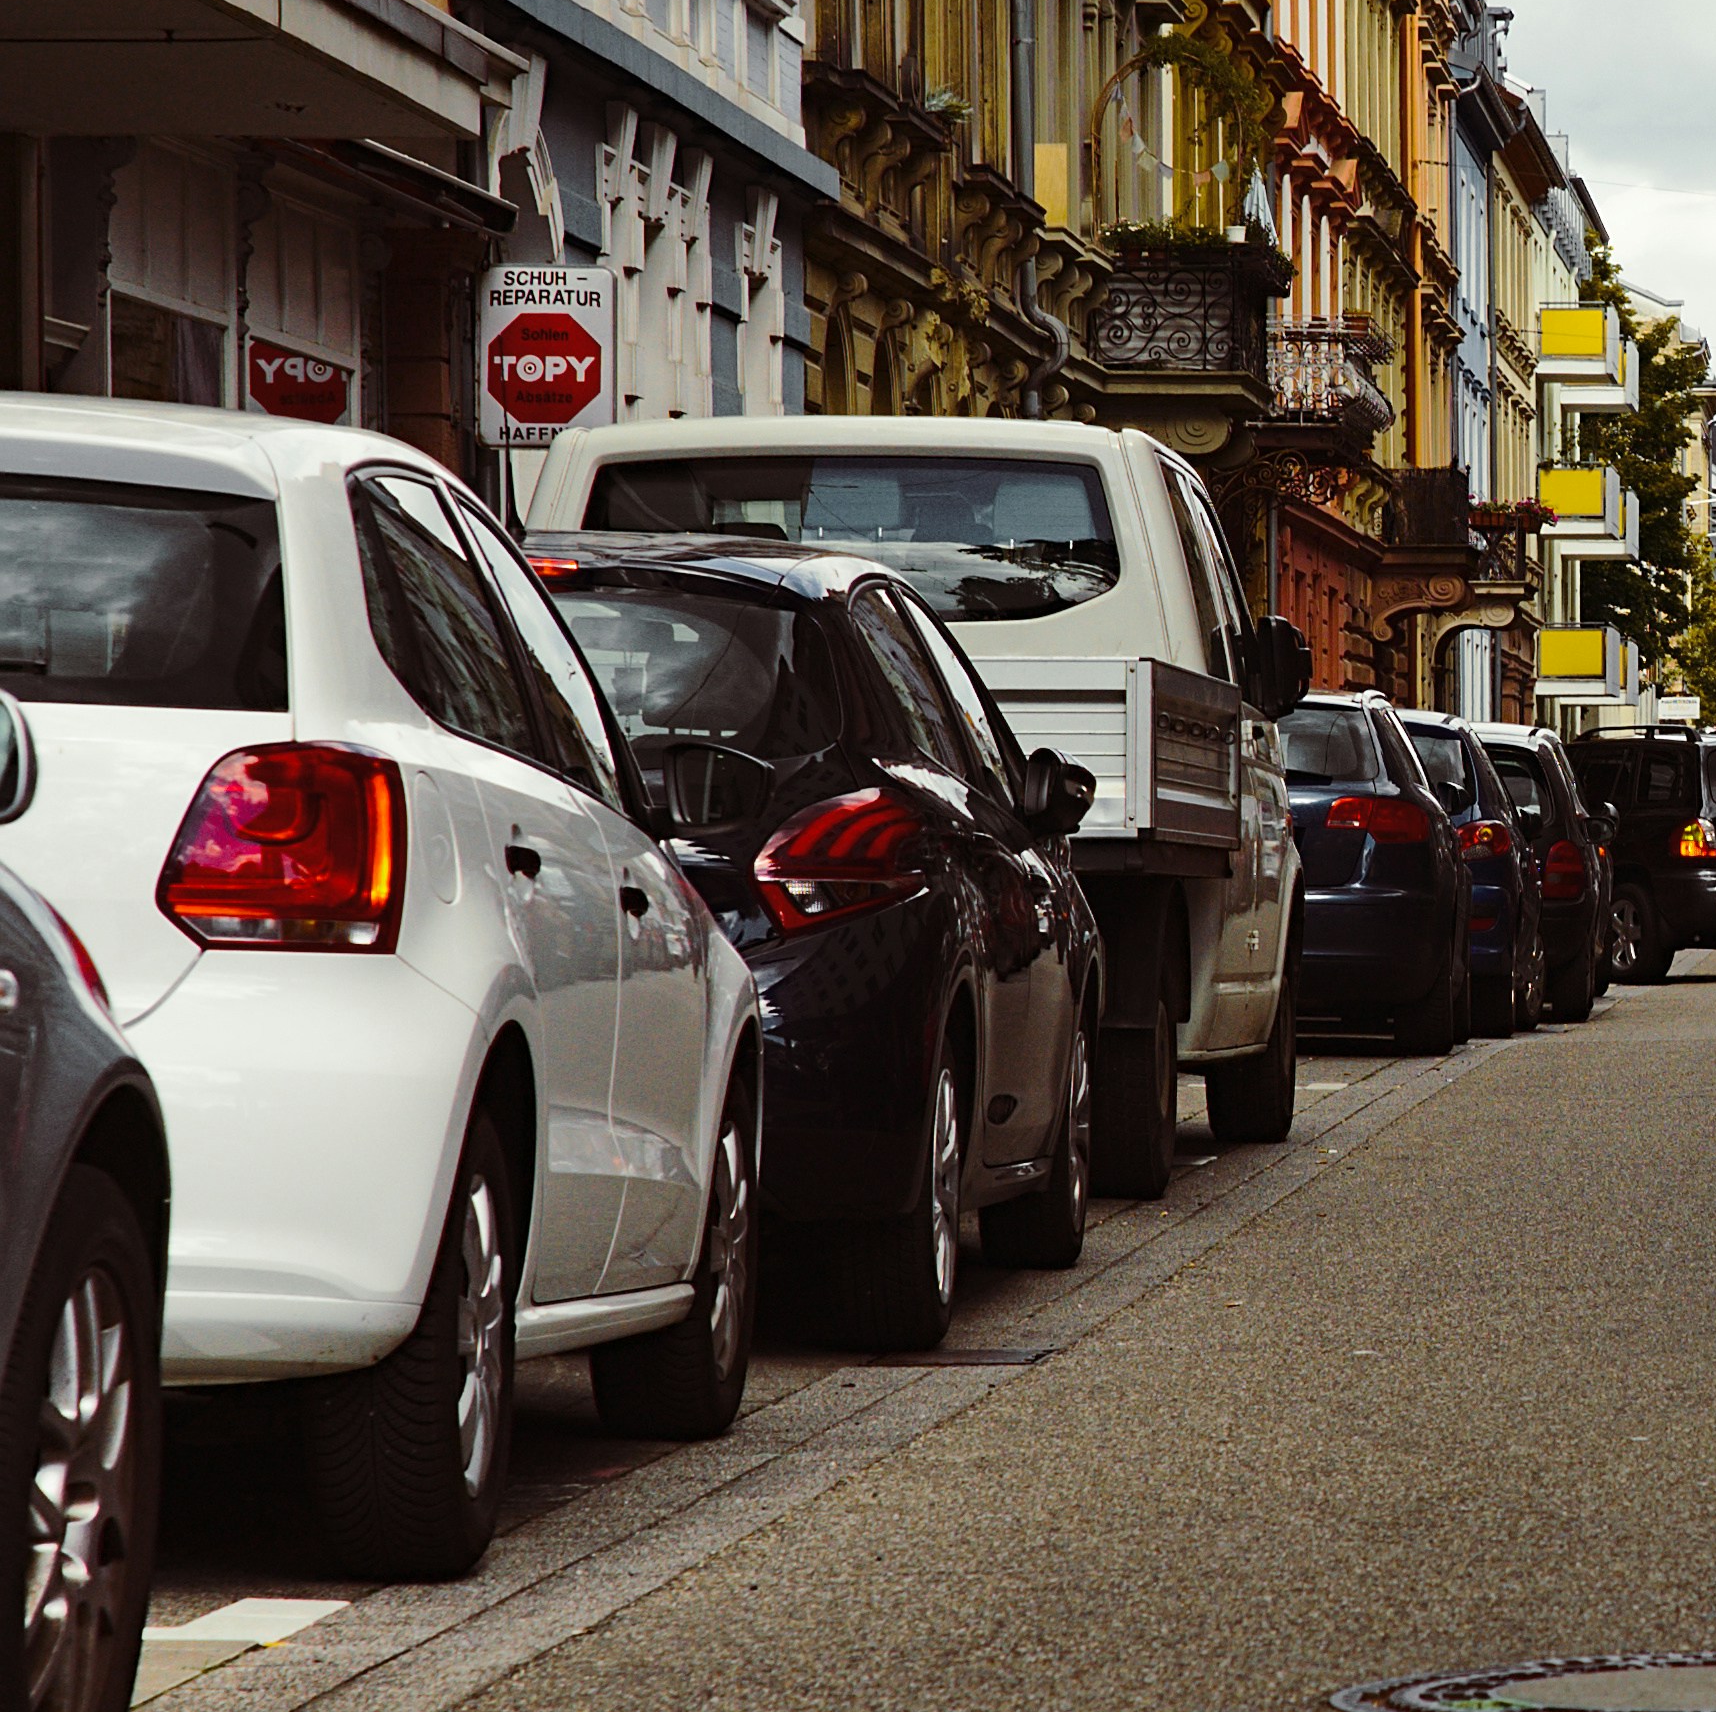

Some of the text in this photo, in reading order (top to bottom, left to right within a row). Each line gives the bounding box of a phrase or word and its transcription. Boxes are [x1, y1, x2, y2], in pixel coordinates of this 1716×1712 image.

[503, 270, 567, 287] SCHUH
[489, 289, 601, 308] REPARATUR
[520, 328, 569, 342] Sohlen
[493, 354, 596, 383] TOPY
[514, 390, 574, 405] Absätze
